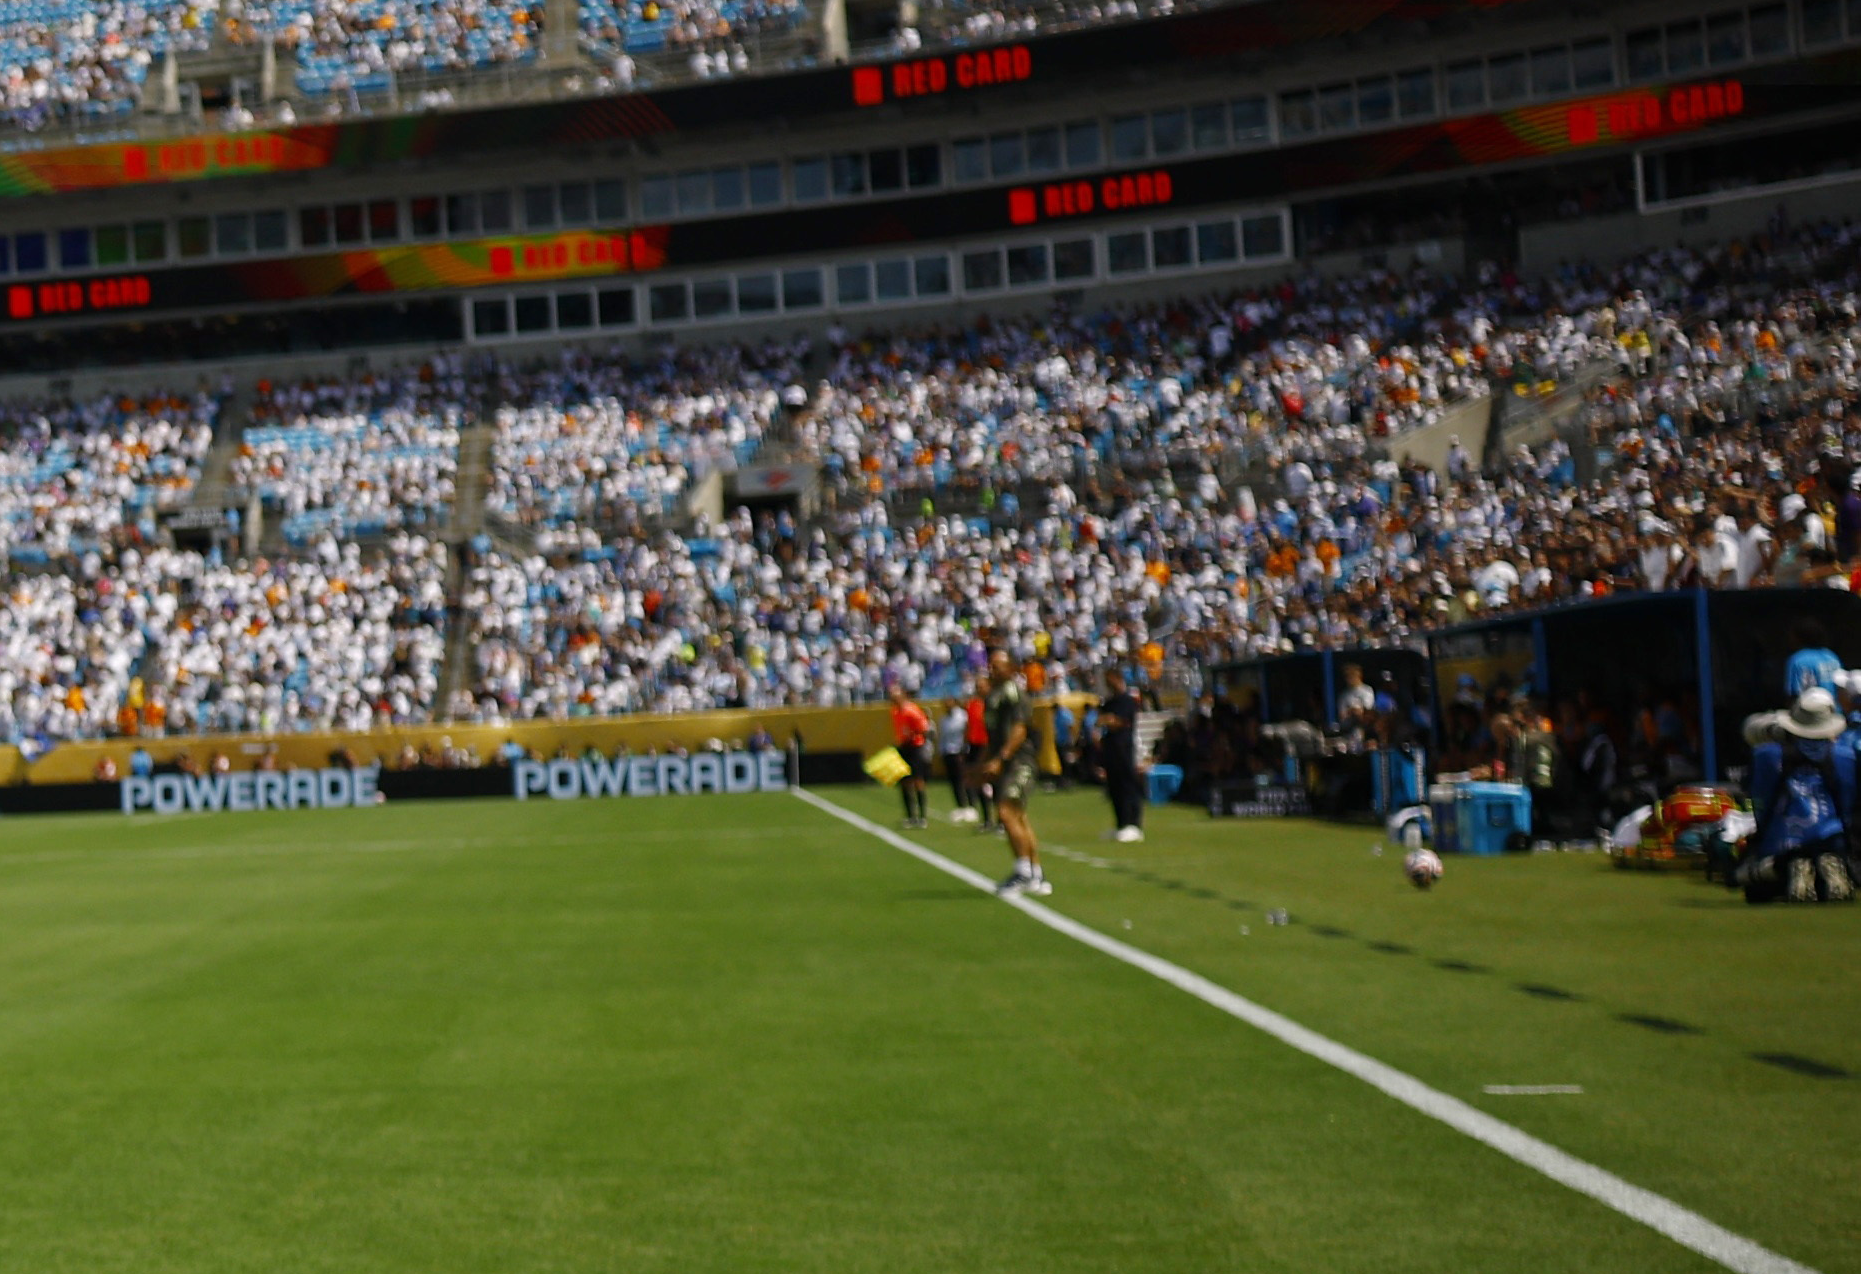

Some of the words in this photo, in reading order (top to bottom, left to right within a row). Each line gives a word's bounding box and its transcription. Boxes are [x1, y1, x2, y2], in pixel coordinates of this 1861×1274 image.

[892, 57, 947, 98] RED
[956, 44, 1031, 88] CARD
[1044, 181, 1094, 217] RED
[1101, 170, 1172, 210] CARD
[121, 766, 379, 814] POWERADE
[514, 750, 786, 801] POWERADE
